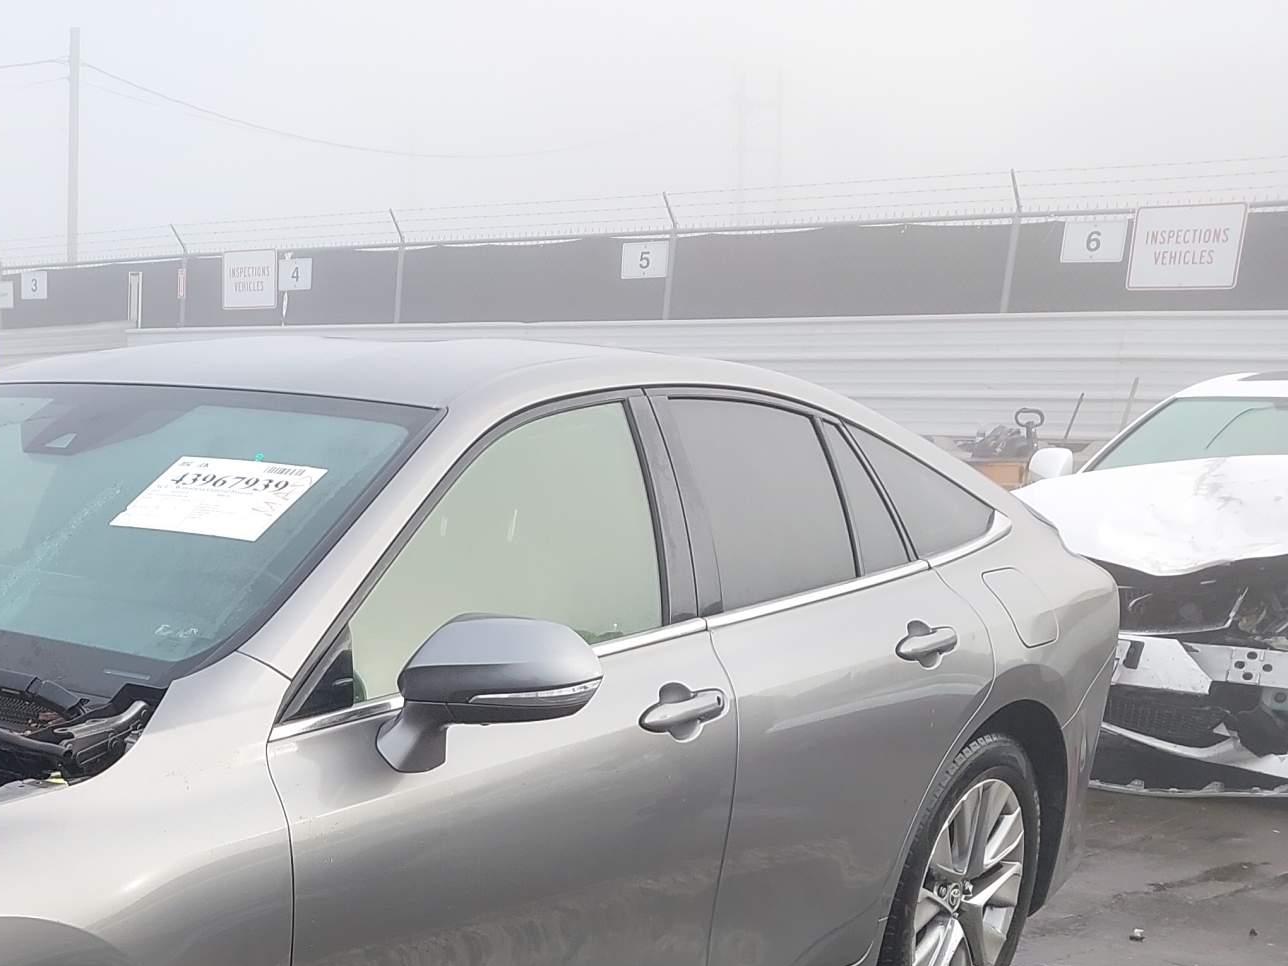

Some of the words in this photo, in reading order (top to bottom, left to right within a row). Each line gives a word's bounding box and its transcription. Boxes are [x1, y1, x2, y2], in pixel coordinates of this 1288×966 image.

[1086, 230, 1101, 252] 6
[1145, 228, 1230, 245] INSPECTIONS
[639, 251, 651, 269] 5
[1154, 250, 1215, 266] VEHICLES
[229, 266, 270, 279] INSPECTIONS
[291, 266, 300, 282] 4
[31, 278, 38, 293] 3
[234, 281, 264, 292] VEHICLES
[170, 472, 289, 493] 43967939
